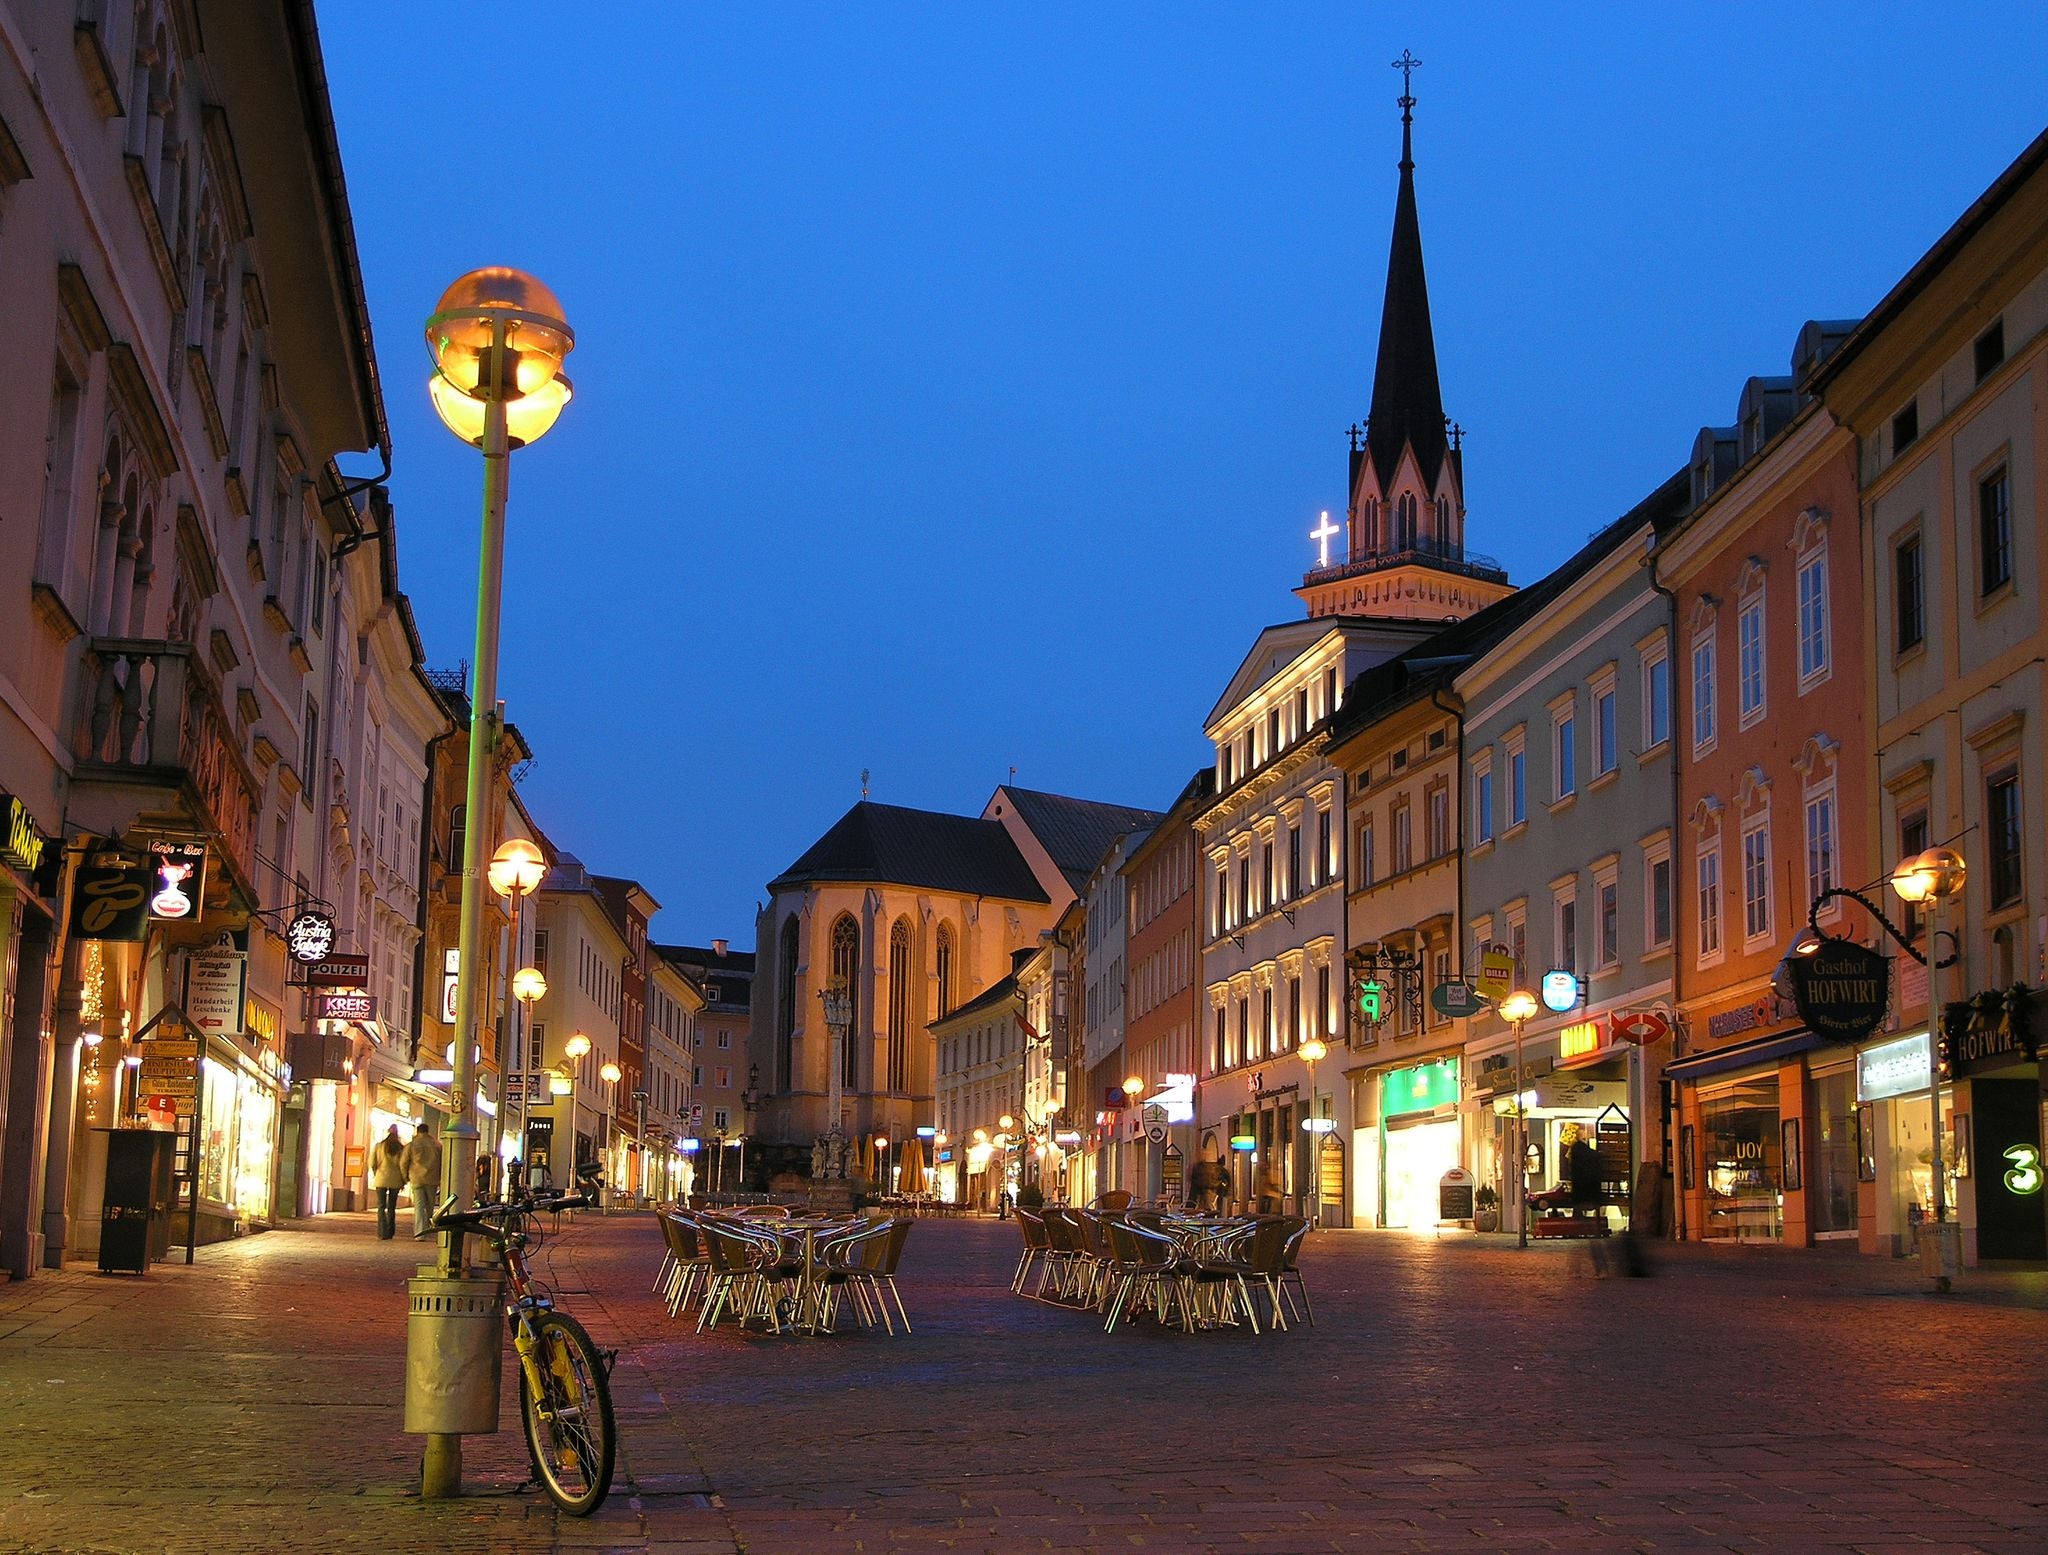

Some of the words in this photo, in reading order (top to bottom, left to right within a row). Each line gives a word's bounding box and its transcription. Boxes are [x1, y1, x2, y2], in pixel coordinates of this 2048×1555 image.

[184, 844, 203, 856] Bar
[289, 918, 331, 937] Austria
[291, 936, 331, 956] Tabak
[312, 964, 362, 974] POLIZEI
[1813, 958, 1868, 975] Gasthof
[1486, 969, 1507, 978] BILLA
[1807, 980, 1878, 1003] HOFWIRT
[193, 997, 233, 1005] Handarbeit
[326, 998, 370, 1011] KREIS
[529, 1121, 551, 1129] Jones
[2003, 1143, 2044, 1195] 3
